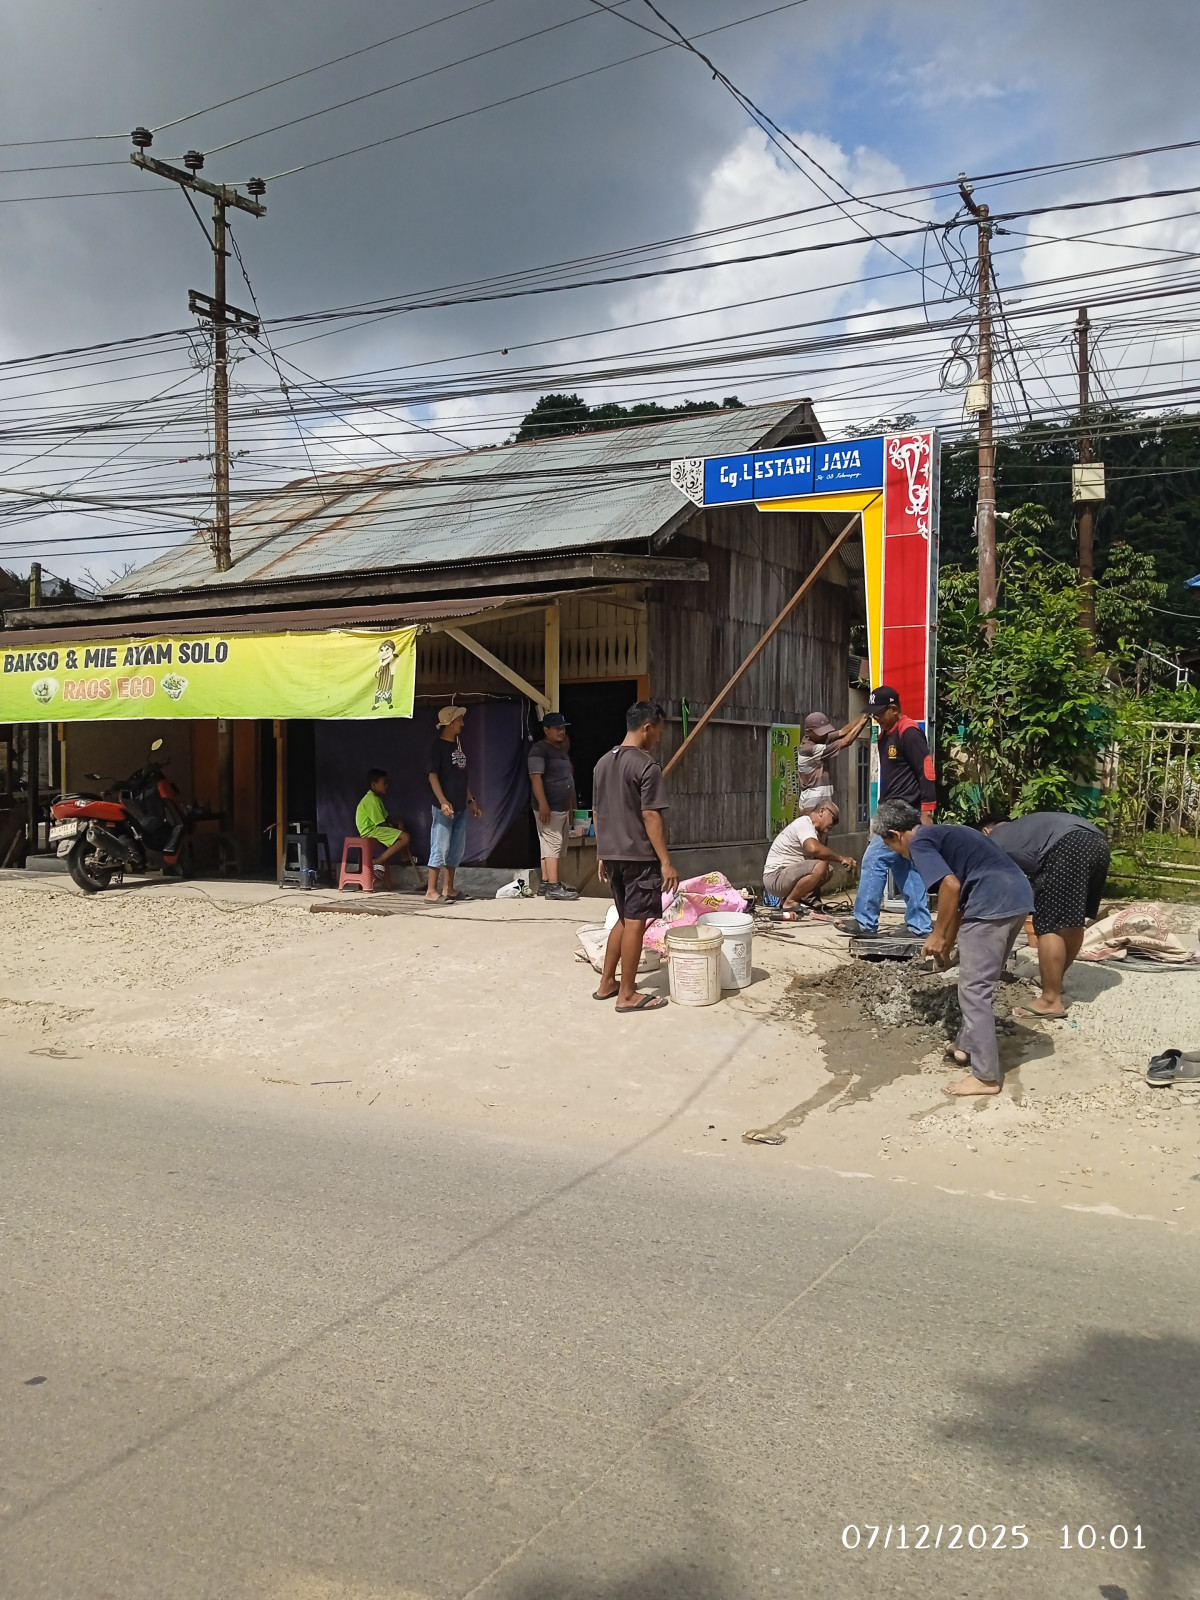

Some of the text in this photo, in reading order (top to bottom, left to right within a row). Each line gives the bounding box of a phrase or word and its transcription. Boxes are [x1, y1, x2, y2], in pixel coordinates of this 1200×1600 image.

[821, 449, 861, 471] JAYA
[3, 641, 229, 673] BAKSO & MIE AYAM SOLO
[63, 676, 156, 701] RAOS ECO
